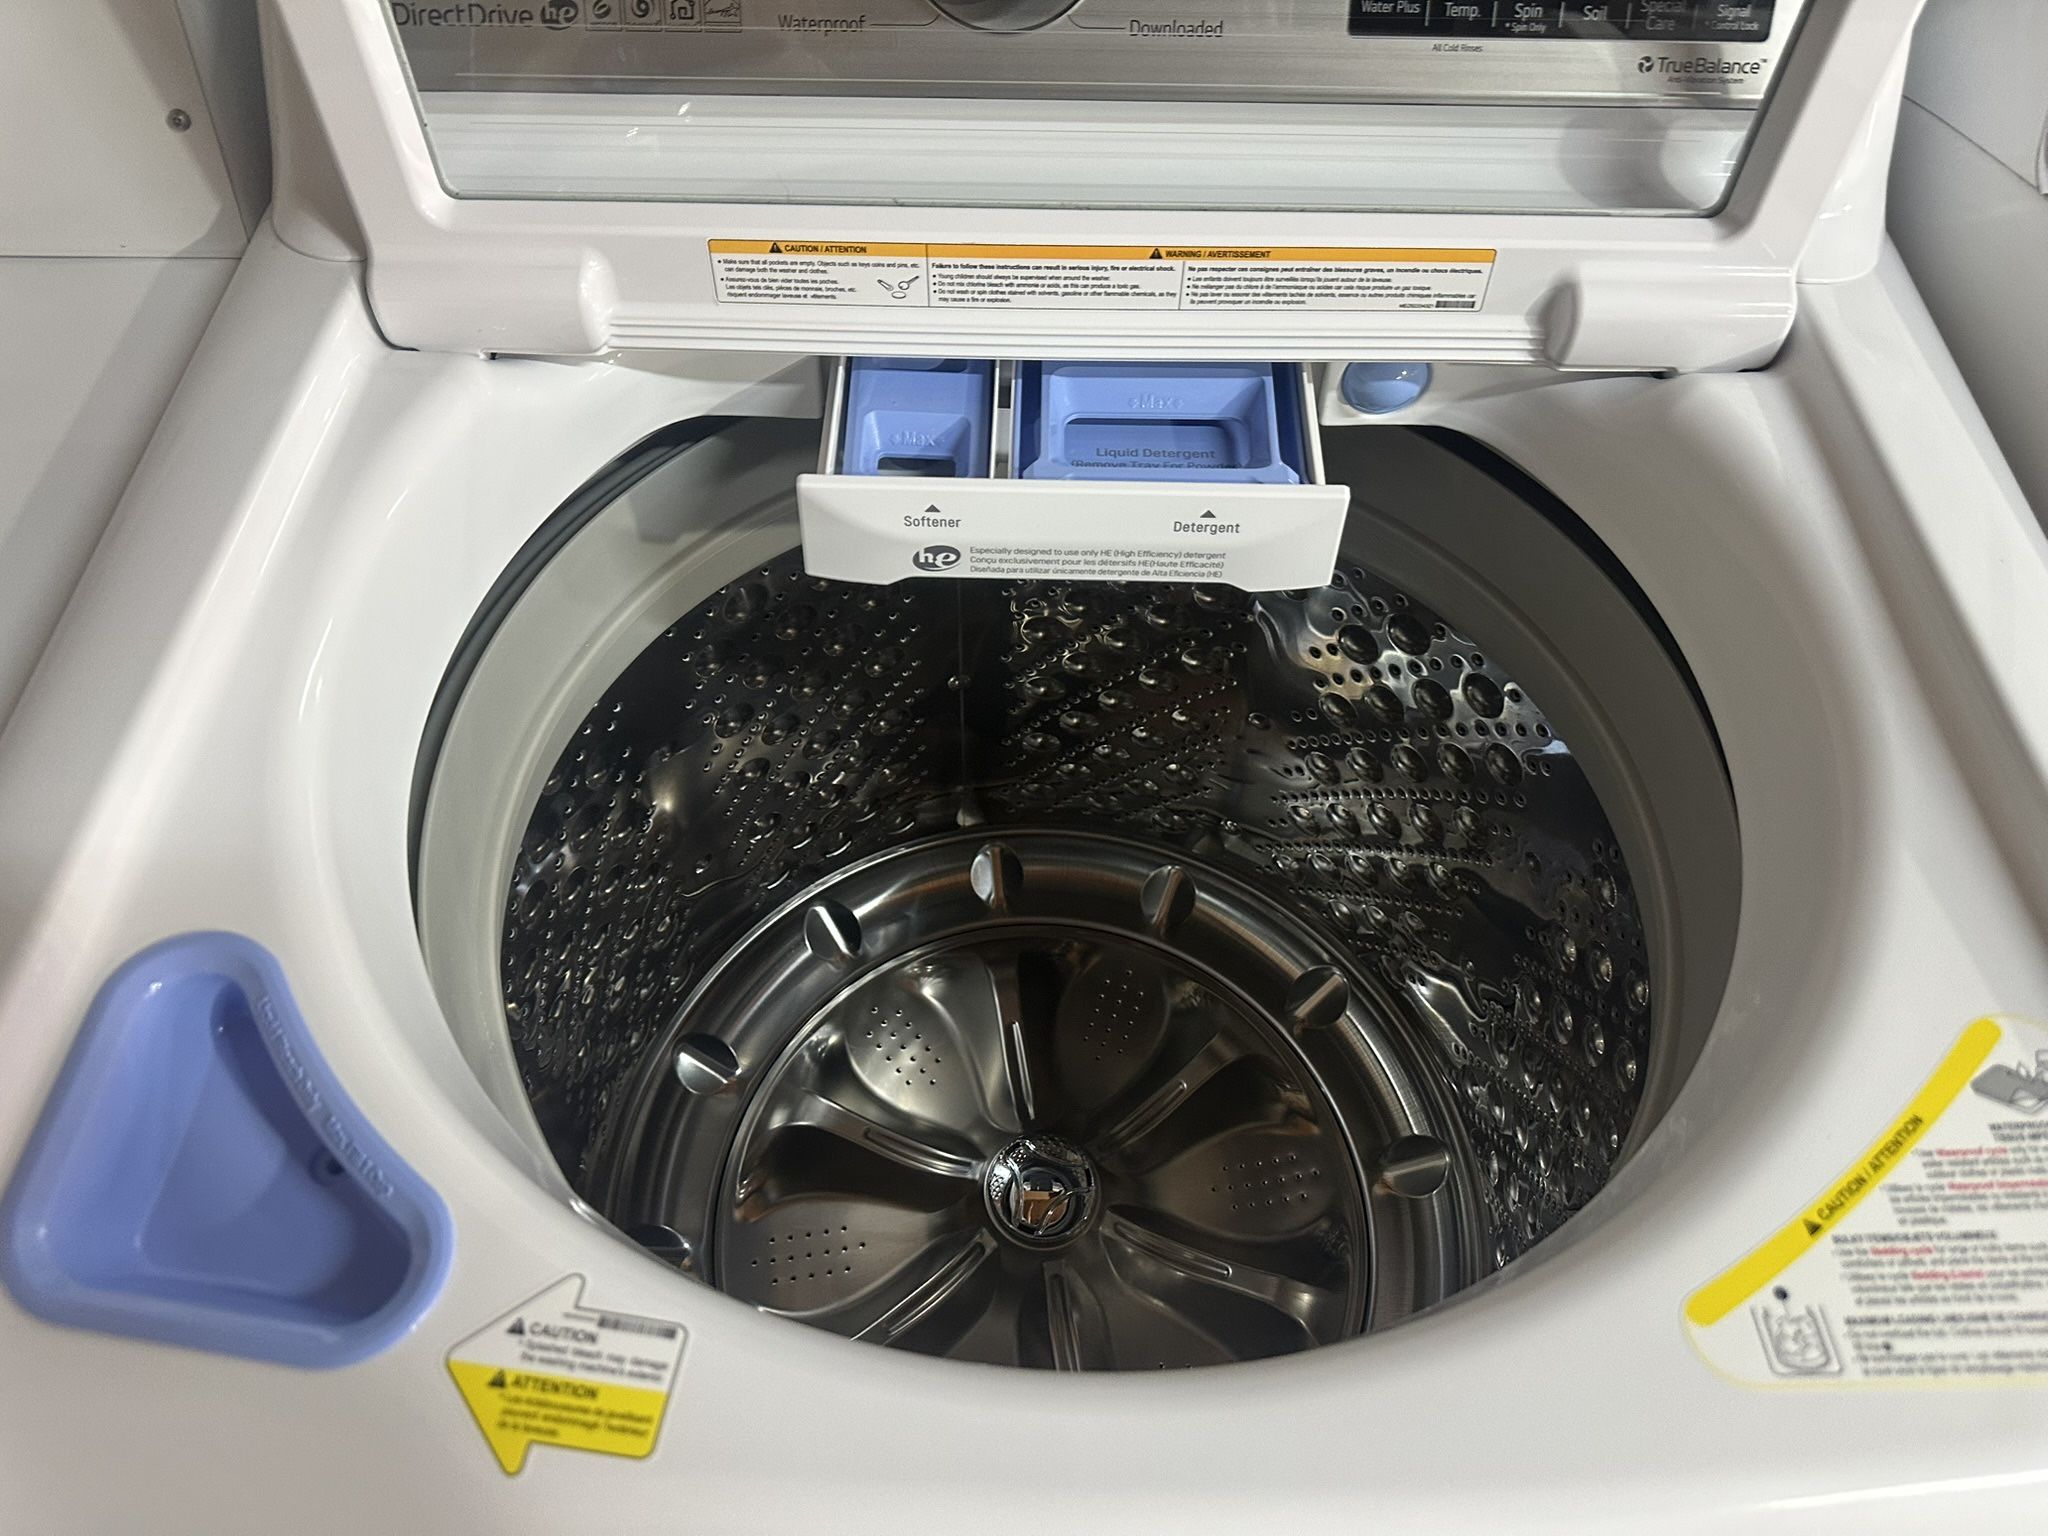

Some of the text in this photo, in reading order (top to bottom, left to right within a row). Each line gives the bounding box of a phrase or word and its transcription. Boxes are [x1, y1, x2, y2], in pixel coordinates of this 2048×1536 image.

[1361, 1, 1393, 13] Water
[1444, 2, 1481, 21] Temp.
[1514, 3, 1544, 22] Spin
[1583, 5, 1608, 21] Soil
[1717, 4, 1752, 20] Signal
[778, 14, 866, 36] Waterproof
[1129, 19, 1224, 38] Downloaded
[1529, 23, 1547, 33] Only
[1645, 16, 1675, 31] Care
[1443, 44, 1459, 52] Cold
[824, 245, 868, 253] ATTENTION
[1166, 250, 1272, 258] WARNING AVERTISSEMENT
[1096, 448, 1217, 460] Liquid Detergent
[1071, 459, 1127, 468] (Remove
[1162, 460, 1184, 468] For
[903, 515, 962, 528] Softener
[1173, 521, 1240, 536] Detergent
[915, 547, 960, 570] he
[970, 547, 1012, 556] Especially
[1014, 548, 1052, 557] designed
[1080, 549, 1098, 558] only
[1100, 549, 1112, 557] HE
[1114, 550, 1136, 559] (High
[1138, 551, 1182, 560] Efficiency)
[1184, 551, 1226, 560] detergent
[970, 556, 998, 565] Conçu
[998, 557, 1060, 565] exclusivement
[1138, 560, 1178, 569] HE(Haute
[1180, 561, 1226, 570] Efficacité)
[1052, 567, 1096, 575] únicamente
[1098, 568, 1140, 577] detergente
[1206, 570, 1224, 579] (HE)
[1817, 1114, 1924, 1220] CAUTION ATTENTION
[529, 1321, 598, 1344] CAUTION
[511, 1375, 598, 1400] ATTENTION
